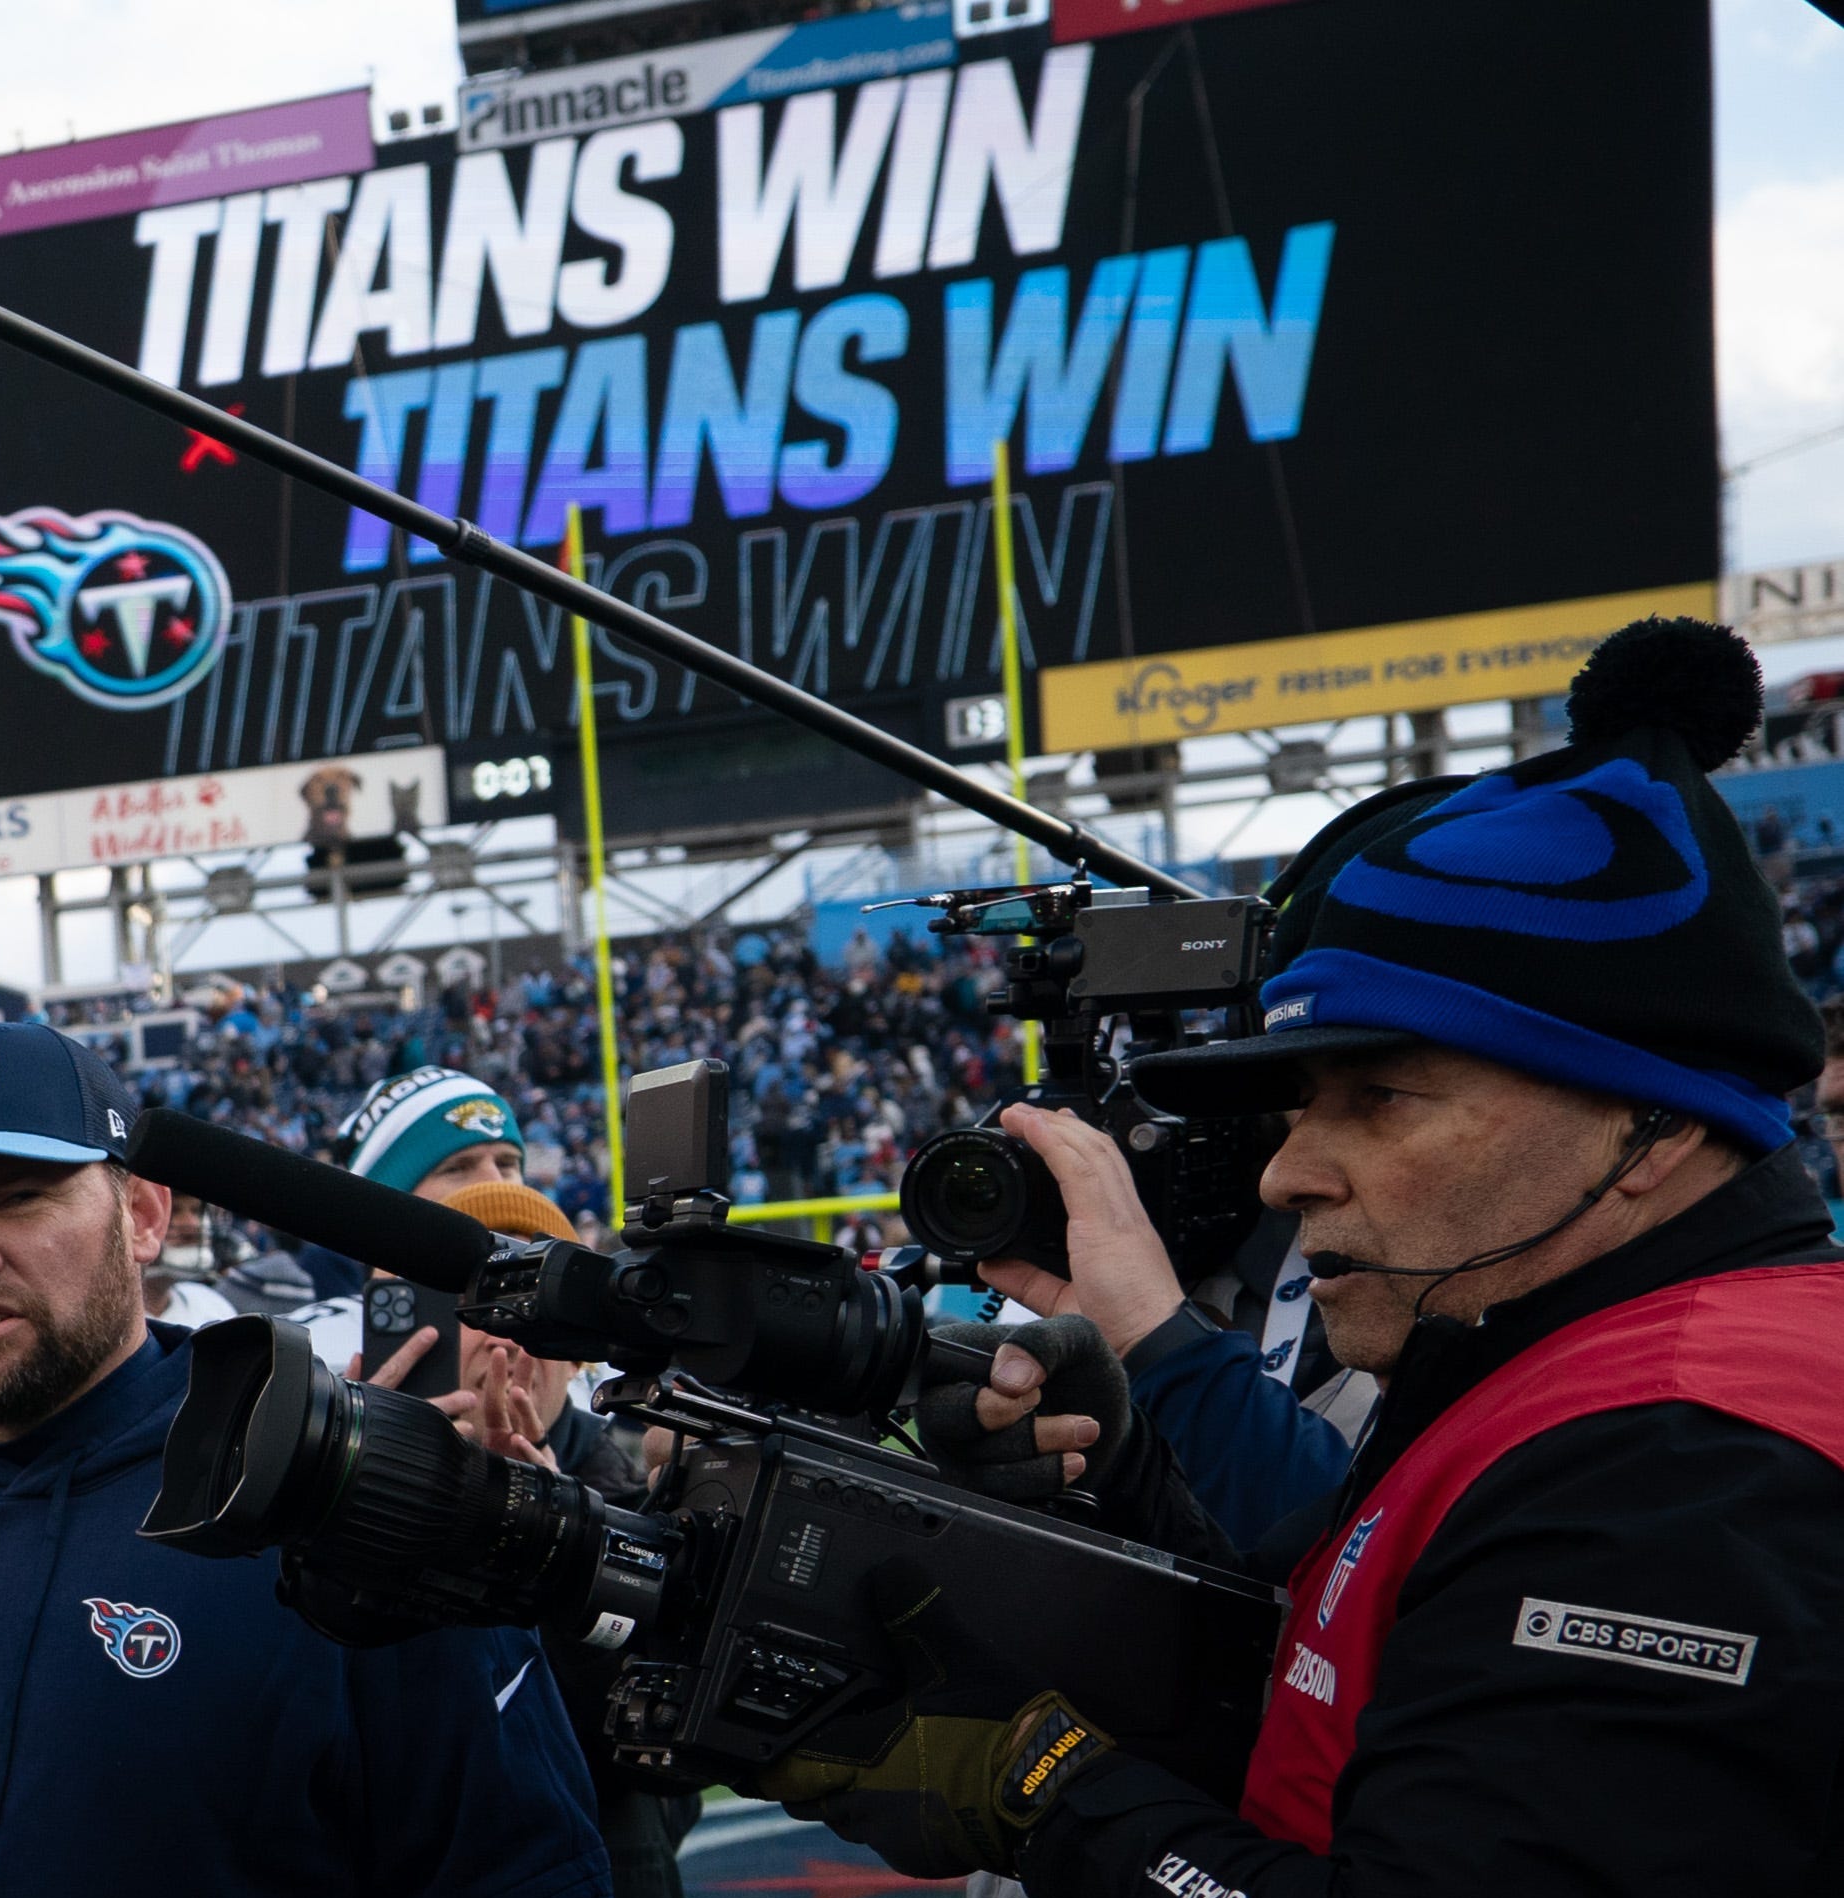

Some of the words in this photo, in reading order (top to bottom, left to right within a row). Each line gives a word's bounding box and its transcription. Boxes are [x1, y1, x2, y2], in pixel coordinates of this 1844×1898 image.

[467, 64, 687, 143] Pinnacle
[7, 160, 139, 206] Ascension
[134, 119, 685, 390] TITANS
[718, 44, 1094, 303] WIN
[344, 292, 911, 574] TITANS
[944, 222, 1333, 486] WIN
[1117, 662, 1261, 732] Kroger
[1278, 665, 1372, 698] FRESH
[1384, 654, 1446, 685] FOR
[1181, 938, 1226, 951] SONY
[618, 1540, 656, 1560] Canon
[1563, 1616, 1613, 1647] CBS
[1618, 1623, 1738, 1671] SPORTS
[1049, 1726, 1086, 1759] FIRM
[1022, 1756, 1056, 1796] GRIP
